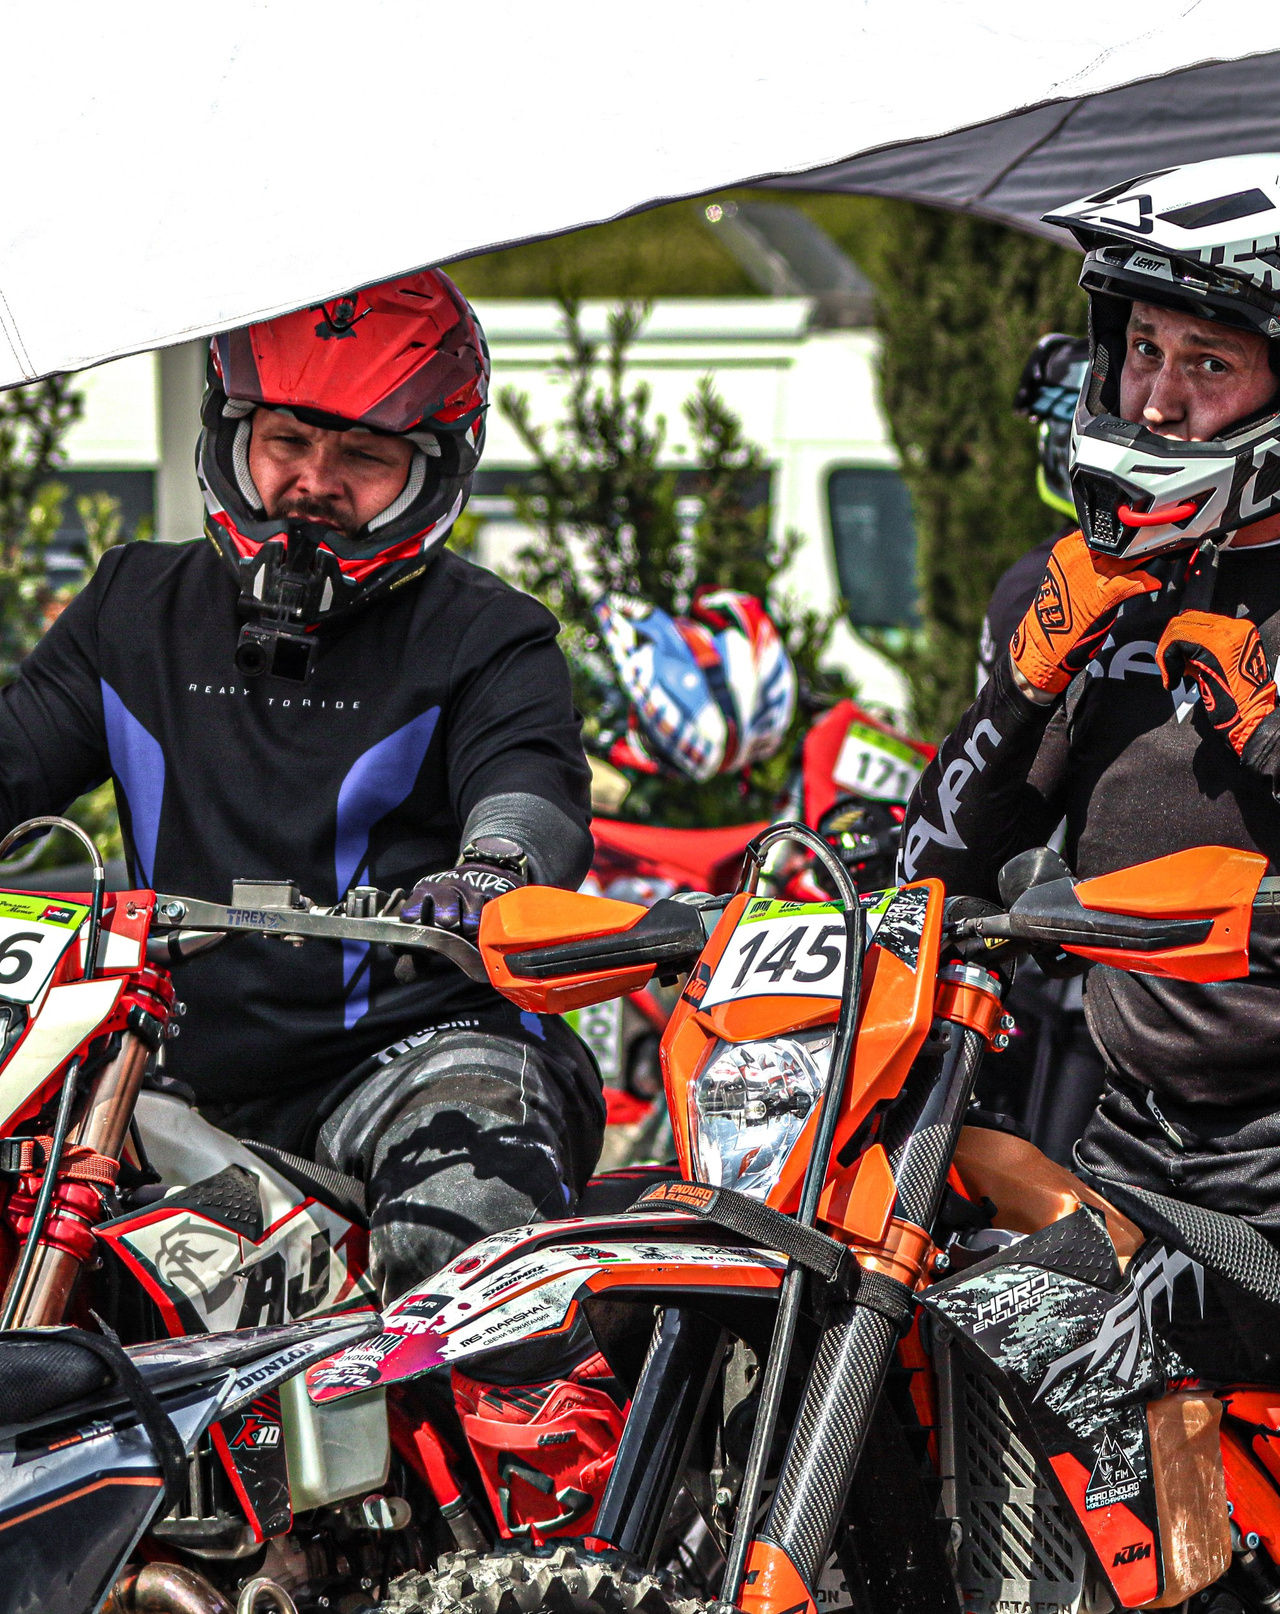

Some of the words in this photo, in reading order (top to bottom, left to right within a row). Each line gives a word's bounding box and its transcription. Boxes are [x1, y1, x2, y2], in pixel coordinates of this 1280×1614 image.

[1132, 256, 1166, 272] LEATT
[188, 683, 250, 696] READY
[268, 698, 291, 707] TO
[302, 698, 360, 709] RIDE
[0, 931, 45, 984] 6
[730, 925, 847, 990] 145
[664, 1193, 710, 1208] ELEMENT
[667, 1183, 715, 1200] ENDURO
[481, 1264, 546, 1299] SHARMAX
[403, 1301, 439, 1309] LAVR
[977, 1271, 1051, 1322] HARD
[973, 1294, 1043, 1335] ENDURO
[483, 1332, 508, 1346] СВЕЧИ
[235, 1342, 316, 1392] DUNLOP
[313, 1375, 373, 1387] ПУТЬ
[1114, 1468, 1130, 1482] FIM
[1085, 1490, 1108, 1505] HARD
[1108, 1481, 1140, 1498] ENDURO
[1112, 1541, 1152, 1568] KTM
